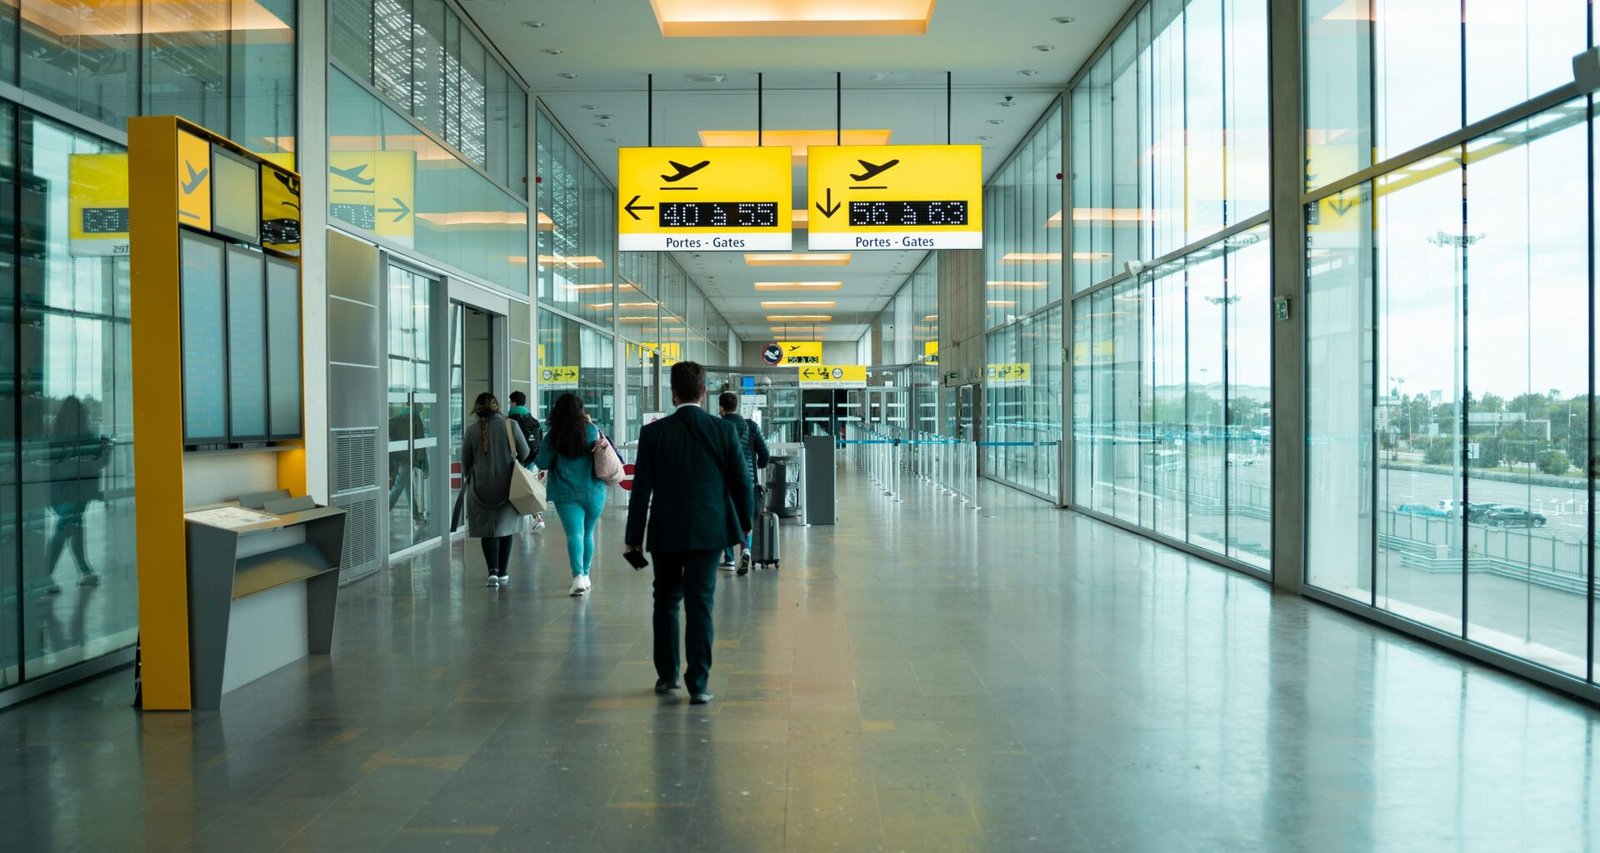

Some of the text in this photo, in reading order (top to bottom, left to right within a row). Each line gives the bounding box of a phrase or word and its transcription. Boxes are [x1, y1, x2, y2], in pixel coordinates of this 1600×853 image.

[664, 203, 774, 226] 40 à 55
[853, 201, 964, 225] 56 à 63
[666, 237, 701, 248] Portes
[713, 237, 745, 248] Gates
[855, 236, 891, 247] Portes
[902, 236, 935, 247] Gates
